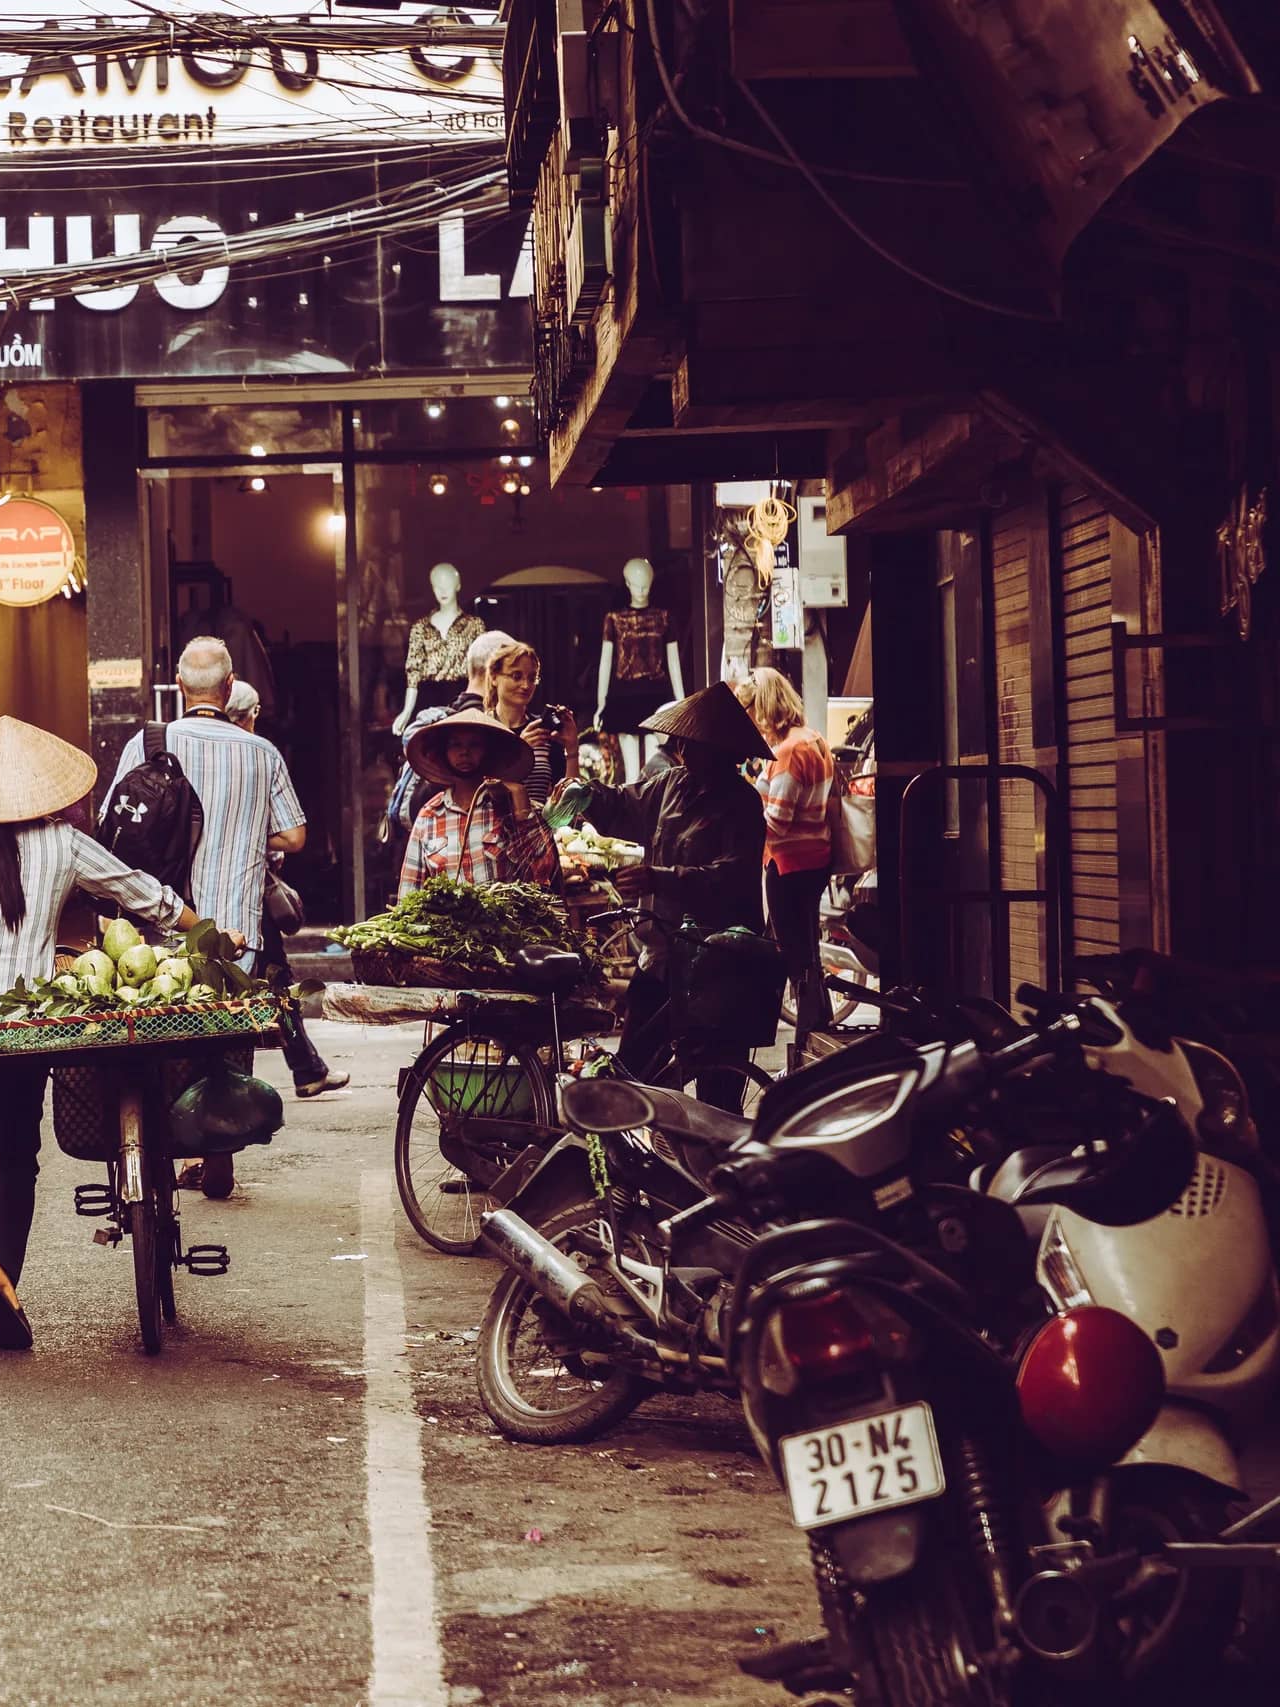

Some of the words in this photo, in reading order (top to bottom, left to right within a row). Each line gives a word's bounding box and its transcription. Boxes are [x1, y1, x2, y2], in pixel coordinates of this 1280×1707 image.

[9, 105, 215, 146] Restaurant
[12, 577, 45, 590] Floor
[810, 1455, 918, 1515] 2125
